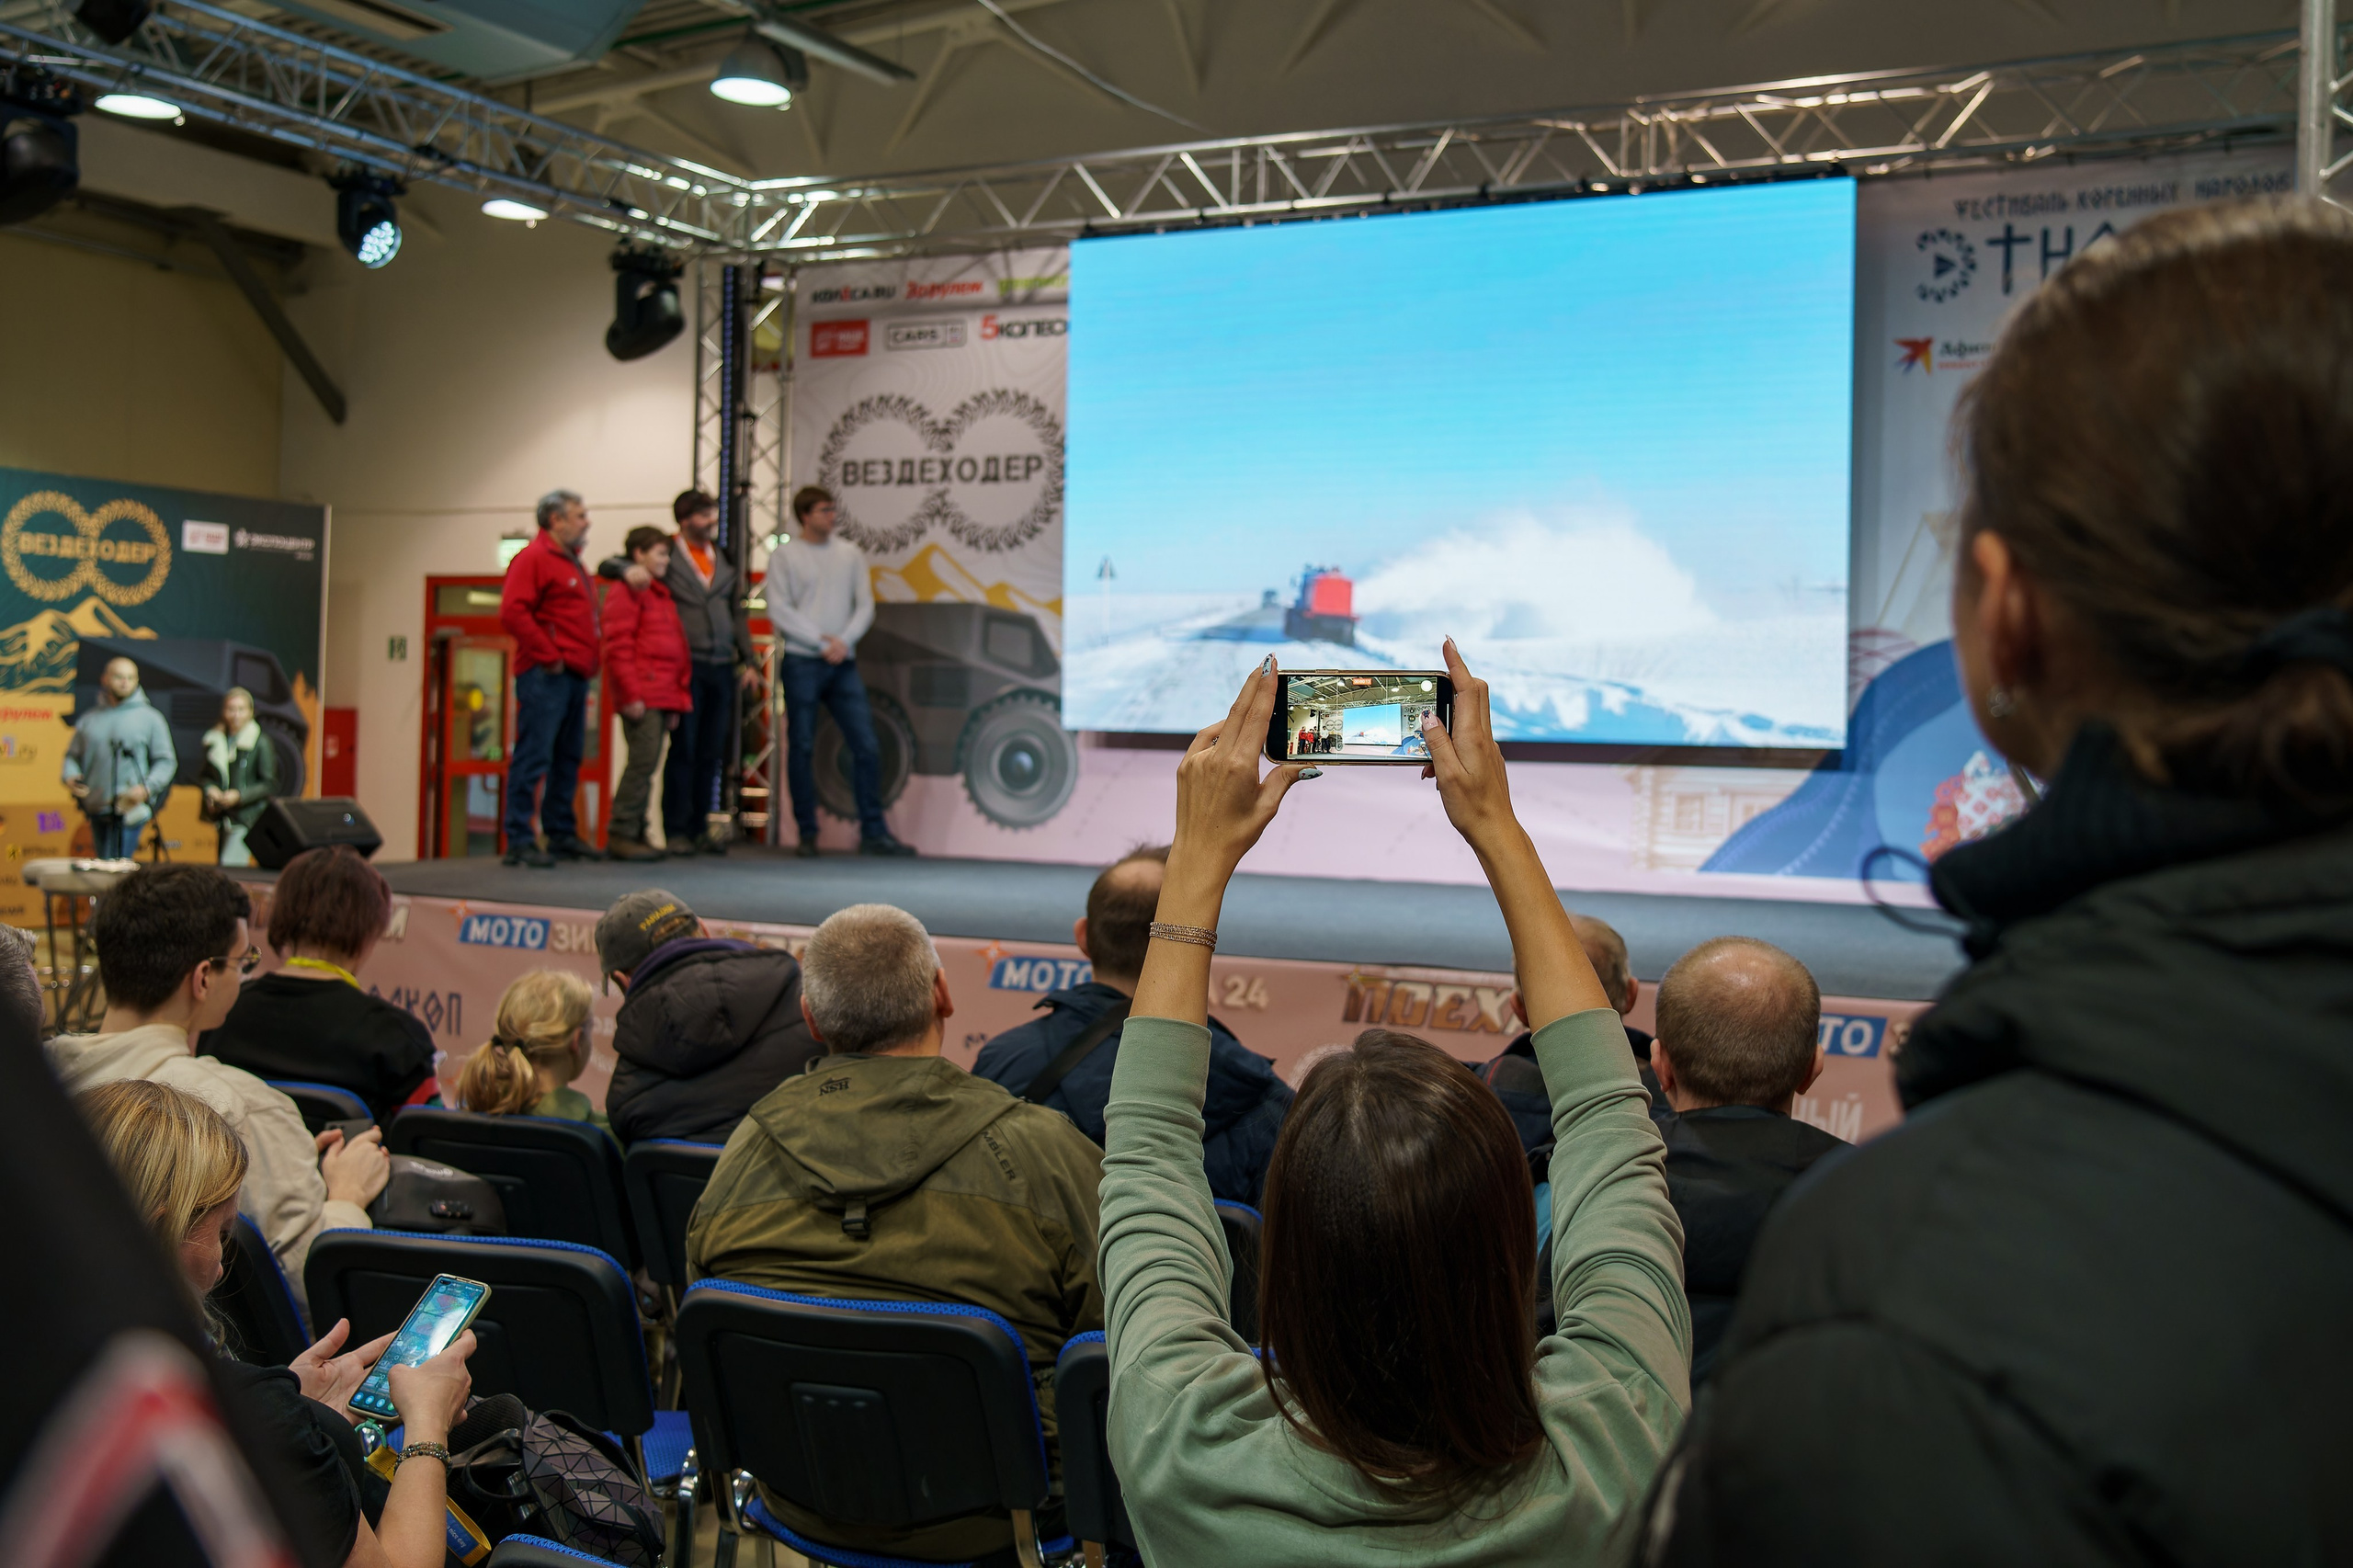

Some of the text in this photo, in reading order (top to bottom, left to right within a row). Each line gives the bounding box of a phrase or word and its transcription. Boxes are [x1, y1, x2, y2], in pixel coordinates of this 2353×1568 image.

[842, 454, 1042, 486] ВЕЗДЕХОДЕР
[18, 531, 157, 563] ВЕЗДЕХОДЕР
[469, 918, 597, 954] МОТО ЗИ
[1223, 975, 1267, 1008] 24
[1818, 1017, 1873, 1054] ТО
